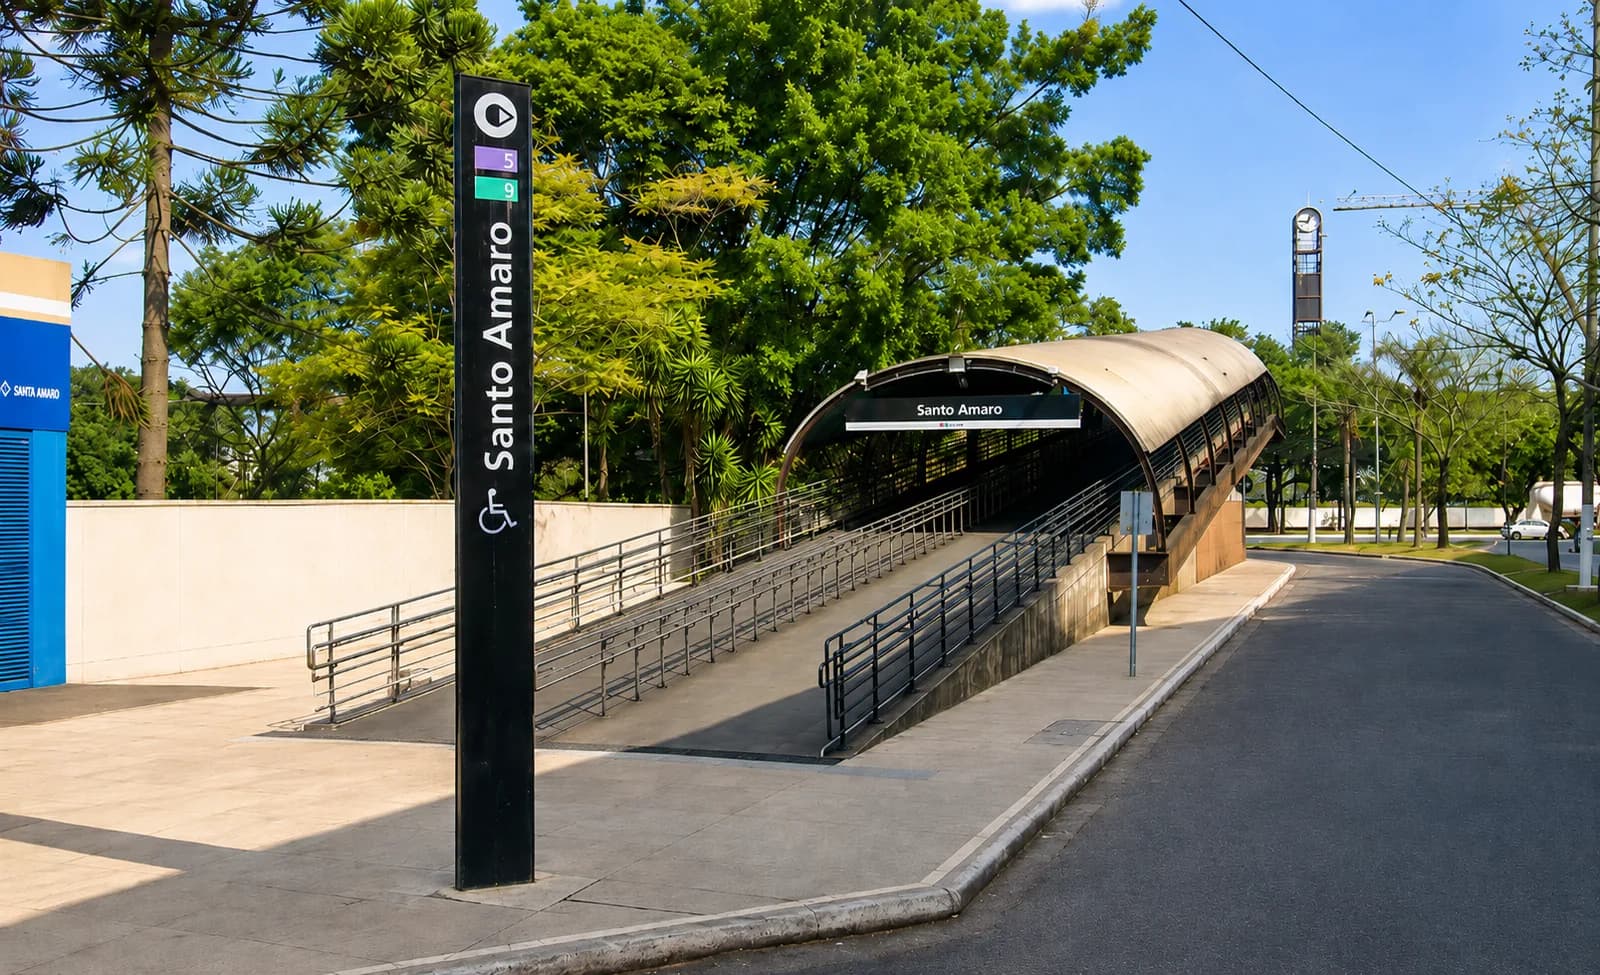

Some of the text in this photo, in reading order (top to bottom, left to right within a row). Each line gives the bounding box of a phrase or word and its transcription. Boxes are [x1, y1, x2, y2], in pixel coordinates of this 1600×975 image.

[503, 153, 514, 169] 5
[504, 183, 514, 199] 9
[482, 221, 514, 471] Santo Amaro
[36, 387, 60, 400] AMARO
[917, 403, 1003, 416] Santo Amaro
